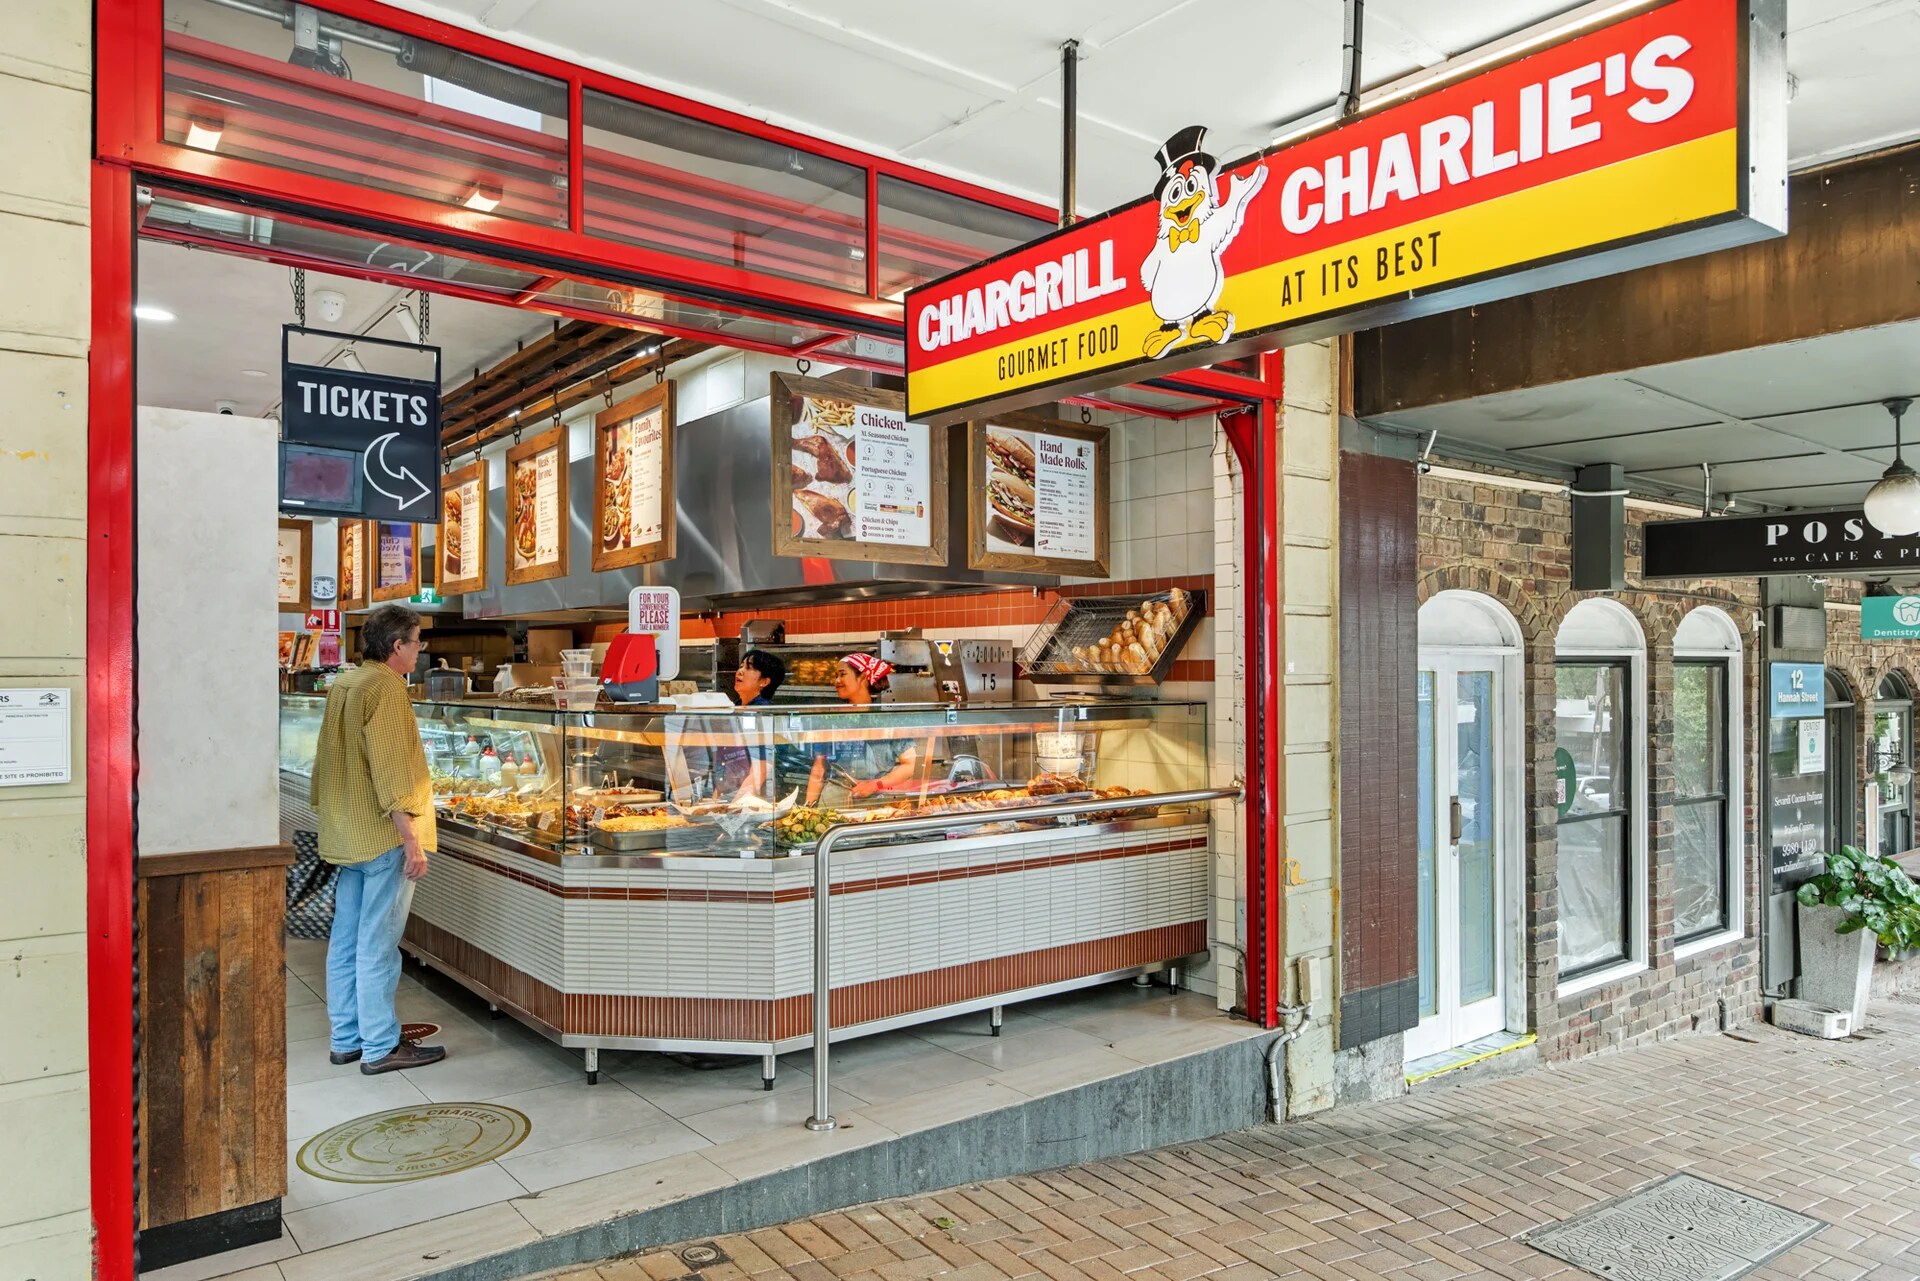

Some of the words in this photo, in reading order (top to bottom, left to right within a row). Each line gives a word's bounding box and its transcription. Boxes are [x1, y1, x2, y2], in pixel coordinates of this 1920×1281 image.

[917, 239, 1126, 352] CHARGRILL
[1280, 35, 1695, 234] CHARLIE'S
[1281, 269, 1304, 306] AT
[1321, 255, 1359, 295] ITS
[1378, 231, 1442, 282] BEST
[998, 337, 1067, 381] GOURMET
[1078, 324, 1119, 360] FOOD
[297, 381, 428, 426] TICKETS
[861, 413, 906, 431] Chicken.
[1040, 440, 1063, 454] Hand
[1040, 454, 1064, 467] Made
[1065, 456, 1088, 471] Rolls.
[1805, 551, 1859, 563] CAFE
[1873, 550, 1883, 560] &
[639, 593, 651, 604] FOR
[653, 593, 669, 604] YOUR
[639, 611, 669, 624] PLEASE
[1874, 629, 1920, 638] Dentistry
[1790, 669, 1804, 688] 12
[1778, 691, 1800, 703] Hannah
[1801, 691, 1819, 703] Street
[394, 1161, 436, 1173] Since
